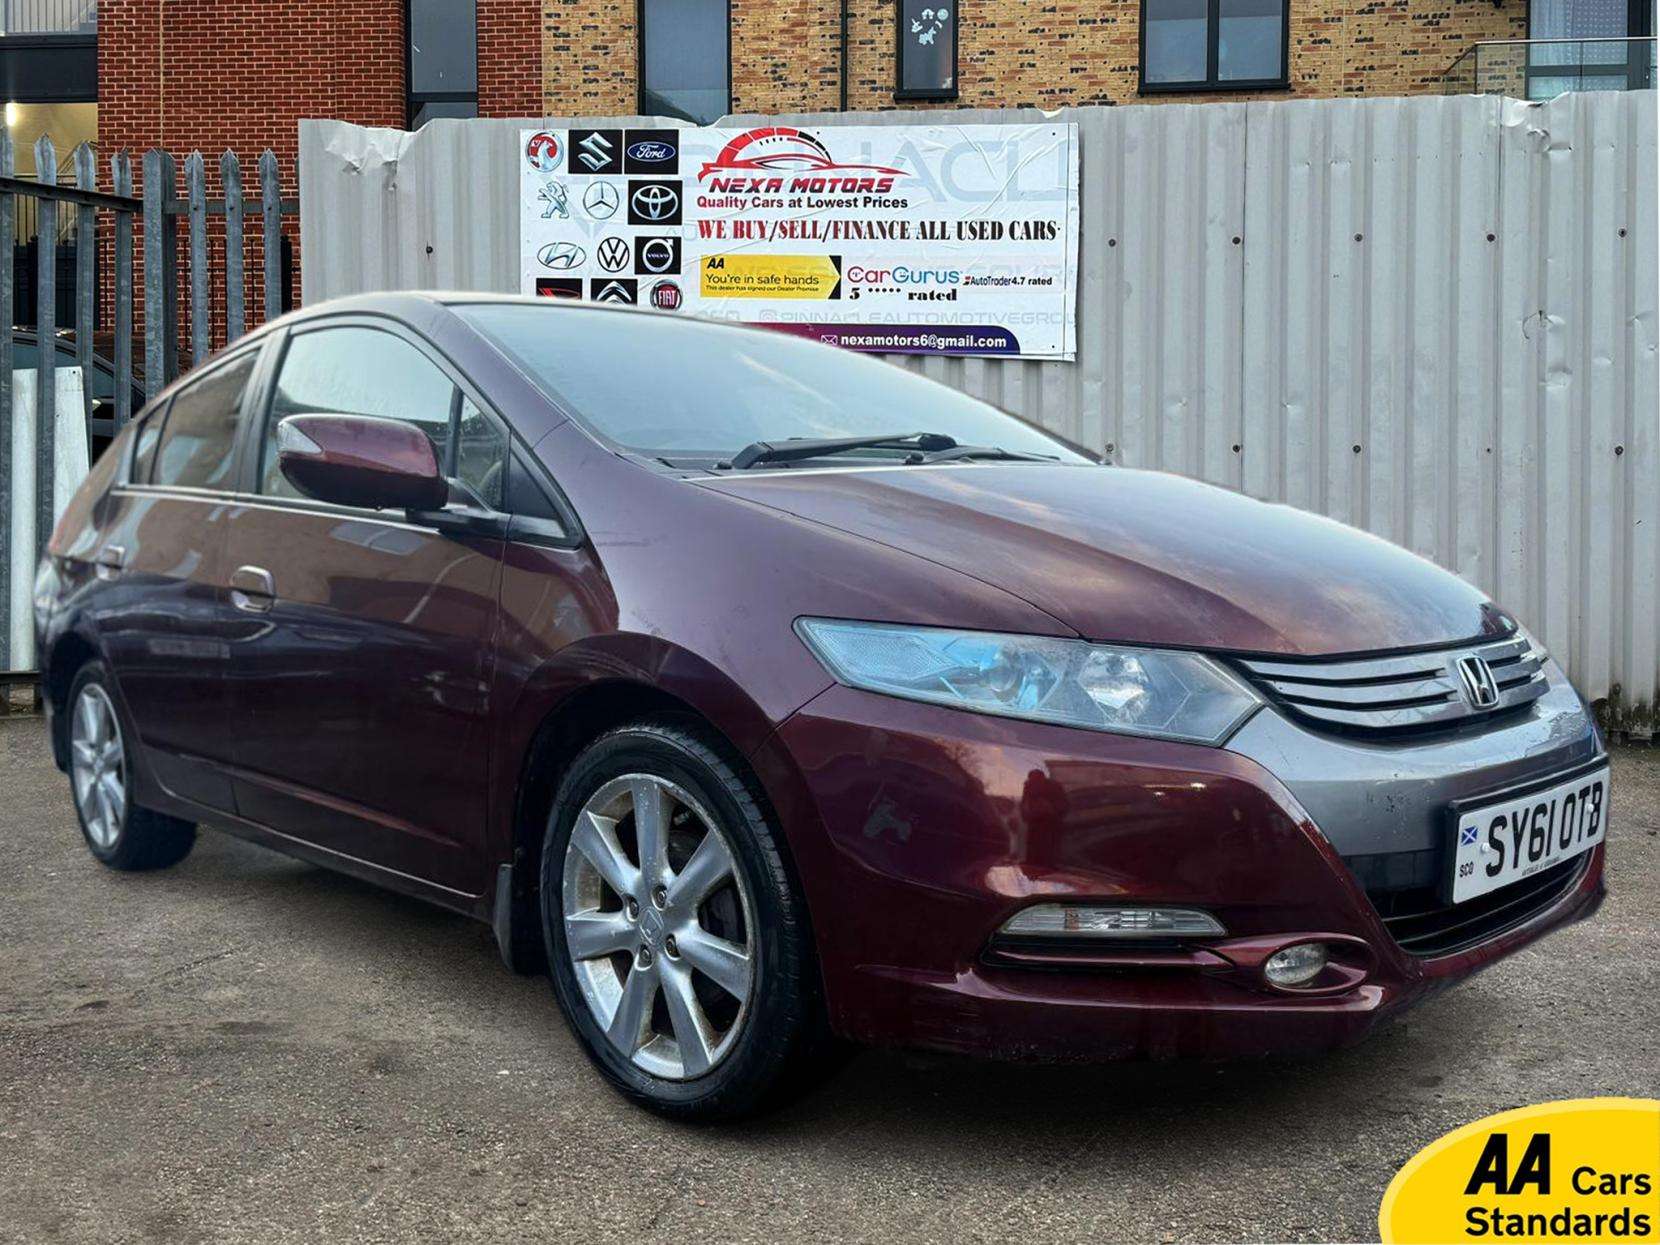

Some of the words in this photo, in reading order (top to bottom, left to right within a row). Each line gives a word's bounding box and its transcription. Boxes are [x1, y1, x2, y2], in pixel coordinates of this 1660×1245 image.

[636, 144, 666, 159] Ford
[709, 178, 784, 194] NEXA
[789, 178, 895, 194] MOTORS
[697, 196, 746, 210] Quality
[752, 196, 784, 208] Cars
[788, 196, 803, 208] at
[807, 196, 859, 209] Lowest
[863, 196, 908, 209] Prices
[698, 220, 727, 240] WE
[917, 221, 951, 240] ALL
[957, 221, 1004, 241] USED
[1008, 221, 1057, 241] CARS
[706, 258, 725, 269] AA
[706, 273, 741, 284] You're
[744, 273, 754, 284] in
[757, 274, 781, 285] safe
[784, 274, 820, 285] hands
[847, 266, 960, 285] CarGurus
[1028, 277, 1053, 287] rated
[747, 285, 766, 293] signed
[849, 287, 861, 301] 5
[908, 289, 958, 302] rated
[658, 290, 676, 306] FIAT
[841, 334, 1007, 349] nexamotors6@gmail.com
[1459, 860, 1475, 878] SCO
